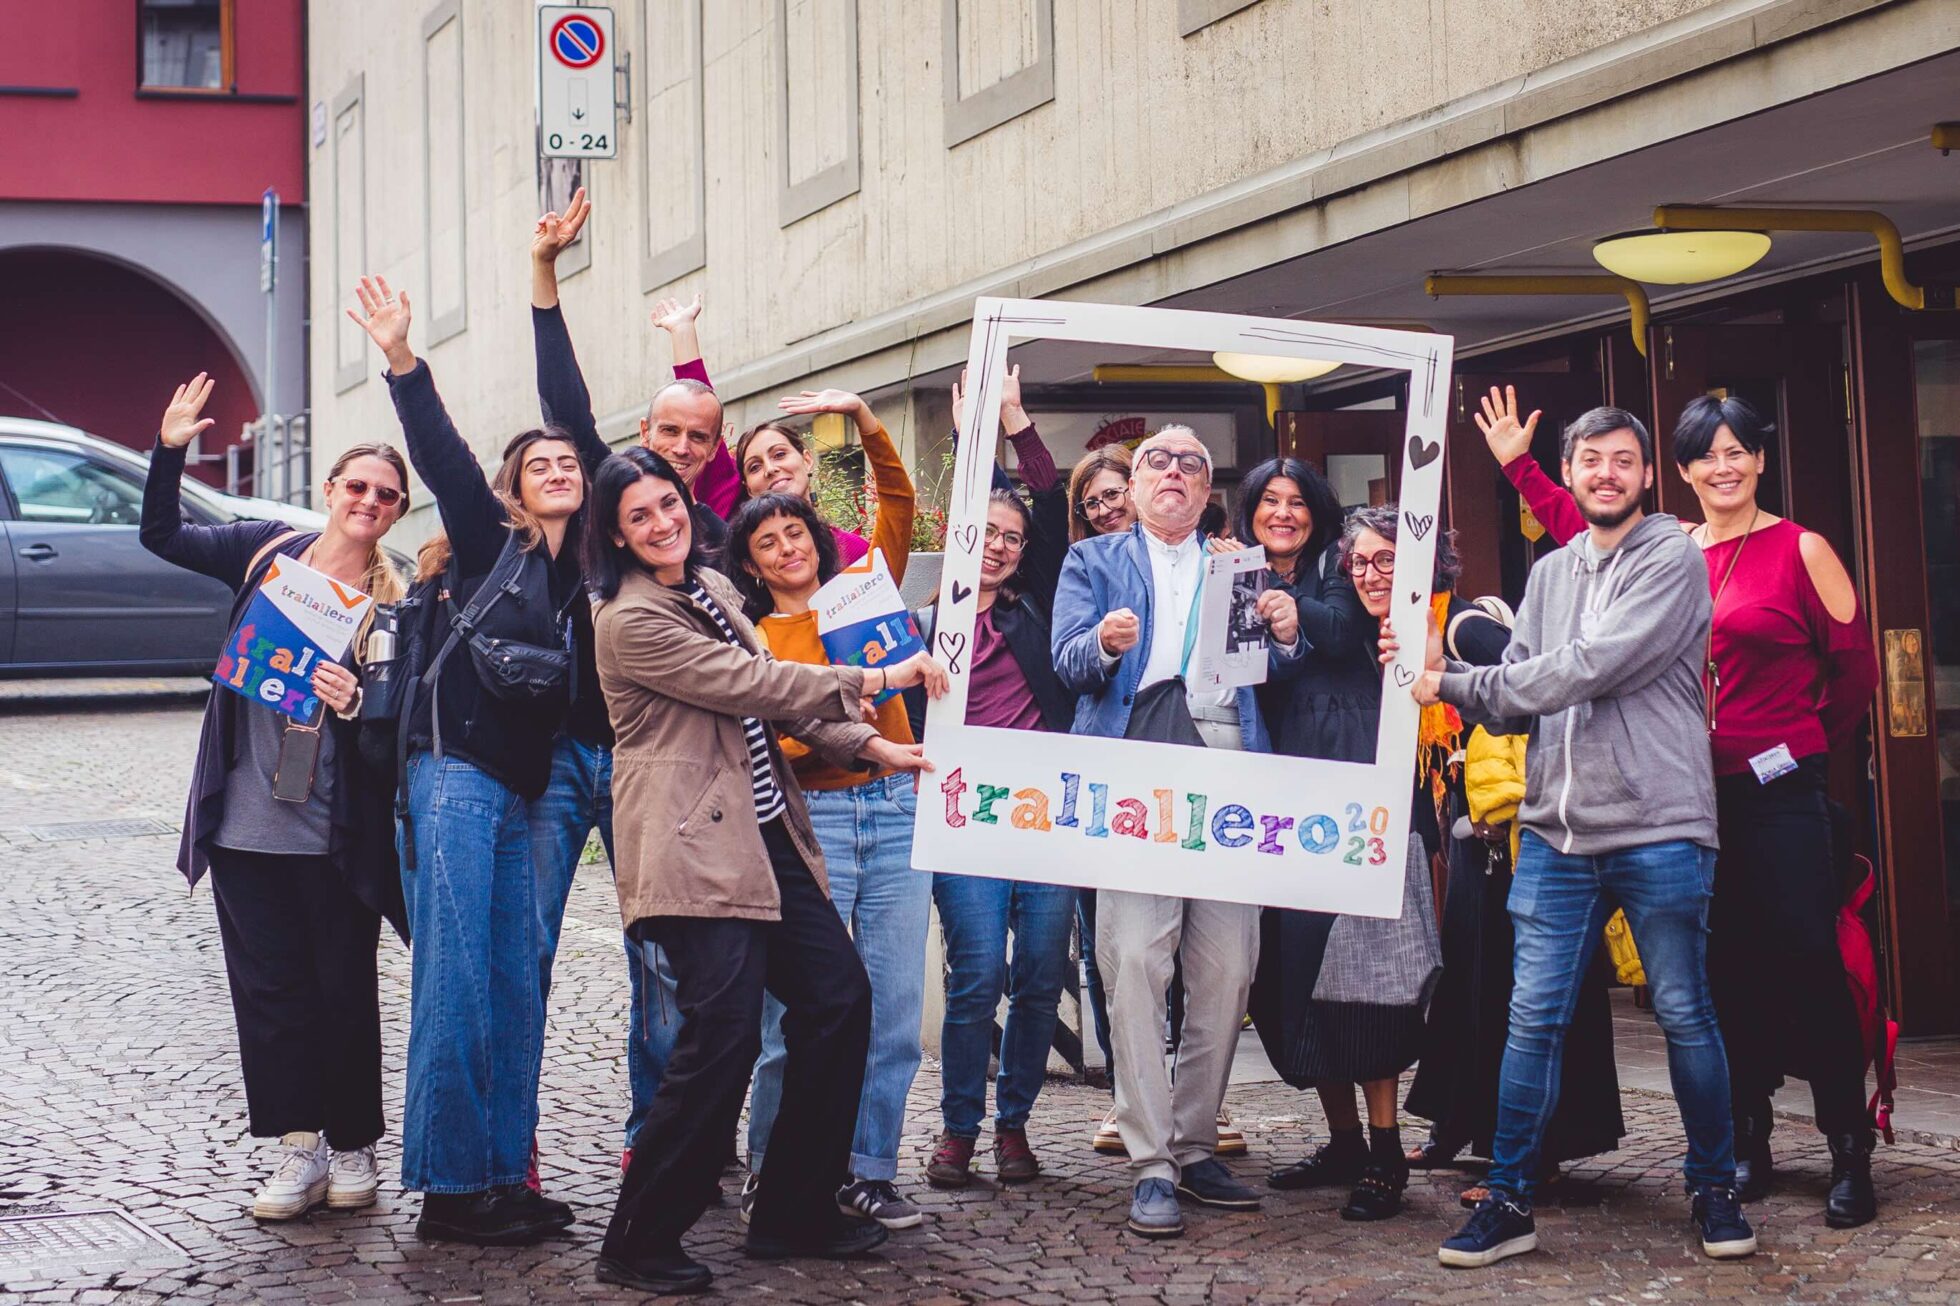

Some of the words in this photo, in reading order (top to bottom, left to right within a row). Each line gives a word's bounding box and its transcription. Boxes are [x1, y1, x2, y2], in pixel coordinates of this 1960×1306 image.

[549, 134, 563, 150] 0
[581, 134, 608, 150] 24
[281, 584, 353, 625] trallallero
[826, 573, 884, 619] trallallero
[236, 624, 322, 684] tral
[940, 766, 1340, 856] trallallero
[1345, 802, 1389, 835] 20
[1343, 836, 1387, 866] 23
